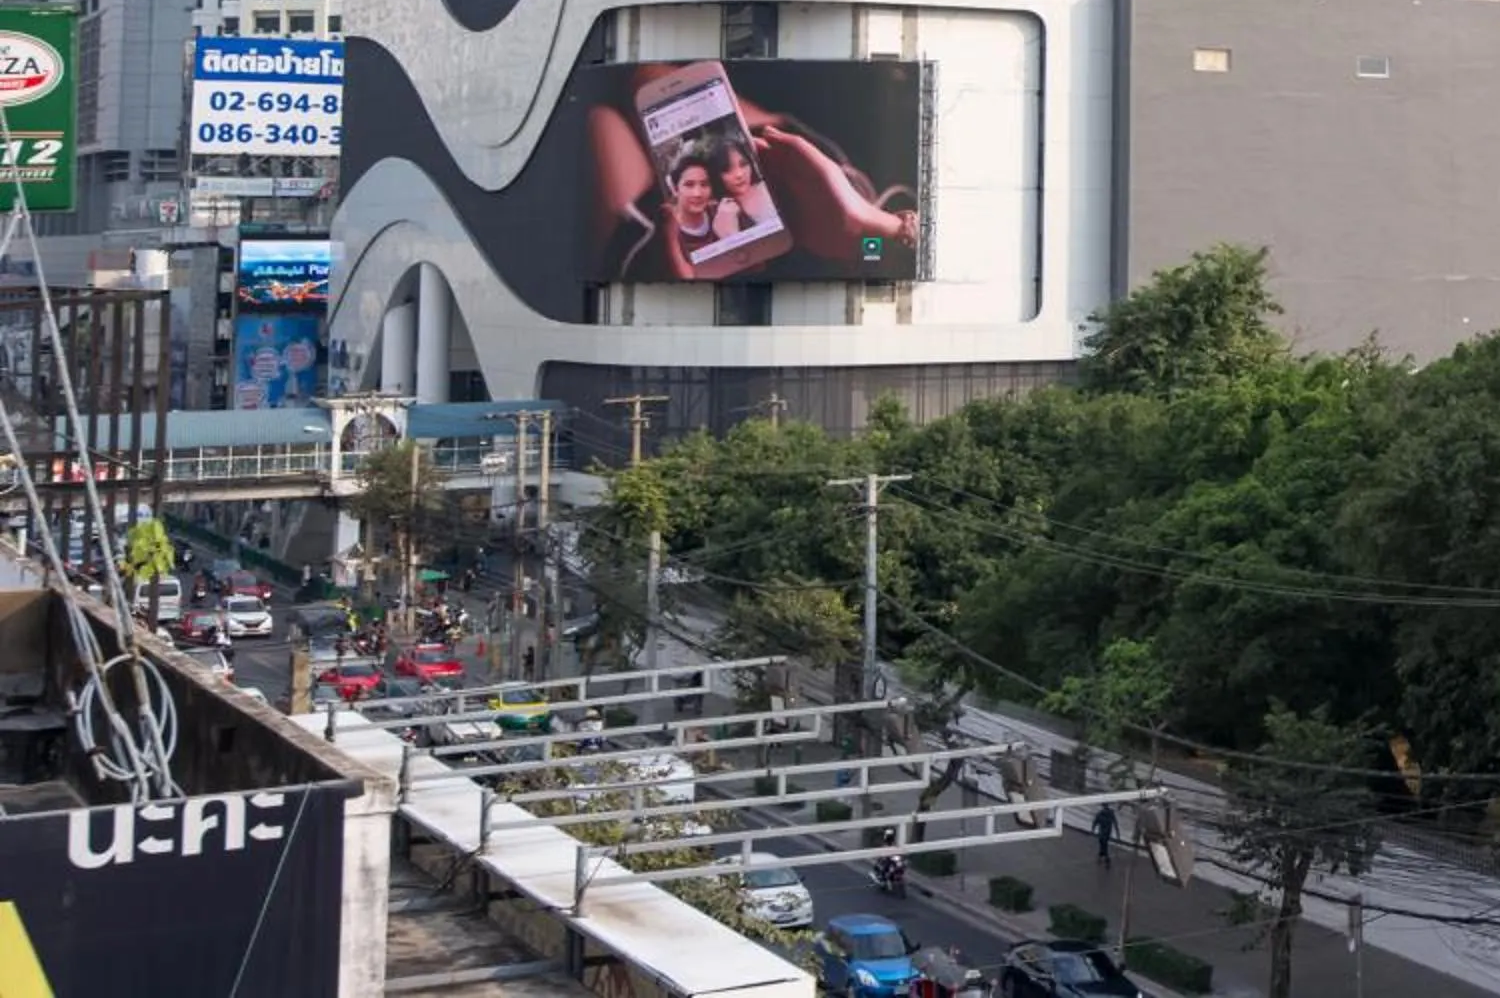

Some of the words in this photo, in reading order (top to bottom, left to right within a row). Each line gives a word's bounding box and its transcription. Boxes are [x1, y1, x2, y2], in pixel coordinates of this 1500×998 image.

[0, 57, 41, 75] ZA
[209, 91, 339, 114] 02-694-8
[198, 122, 343, 145] 086-340-3
